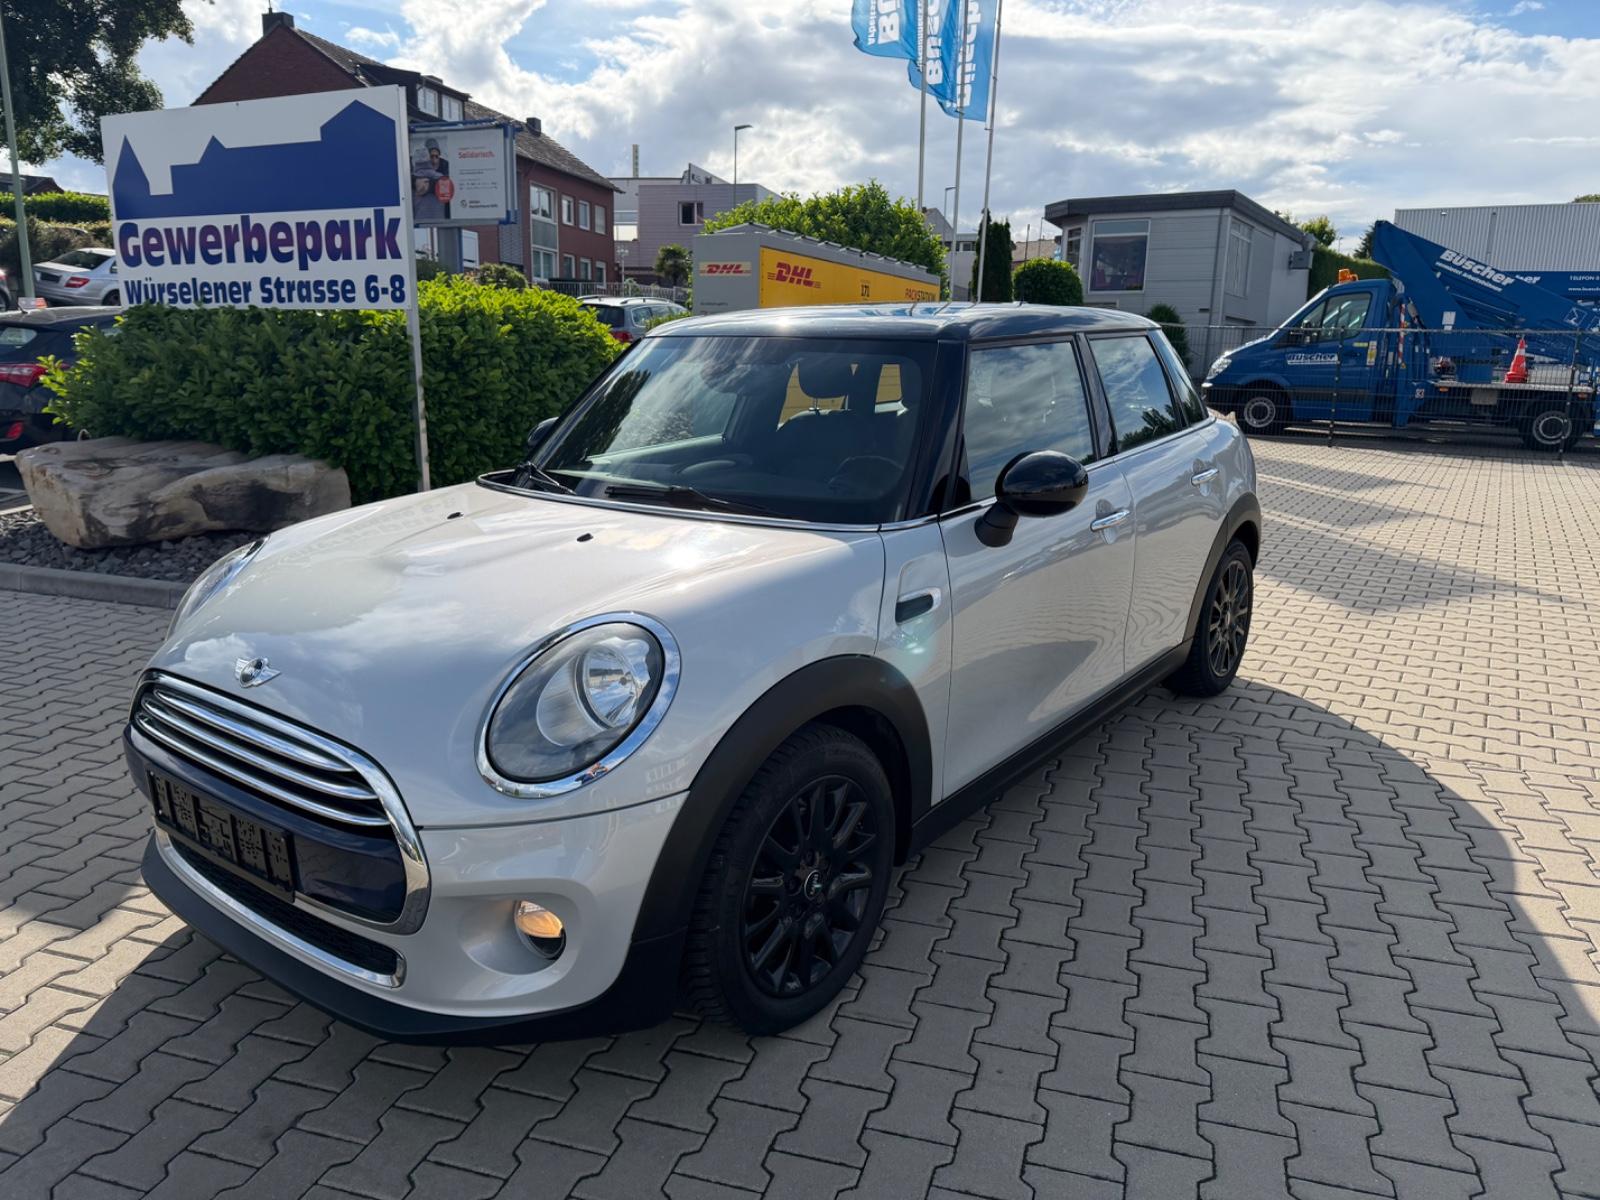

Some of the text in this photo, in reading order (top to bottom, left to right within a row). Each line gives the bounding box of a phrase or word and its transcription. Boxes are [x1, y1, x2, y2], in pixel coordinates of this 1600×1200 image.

[119, 208, 402, 270] Gewerbepark
[706, 264, 744, 274] DHL
[775, 262, 814, 287] DHL
[1440, 249, 1515, 286] Büscher
[124, 274, 406, 304] Würselener Strasse 6-8
